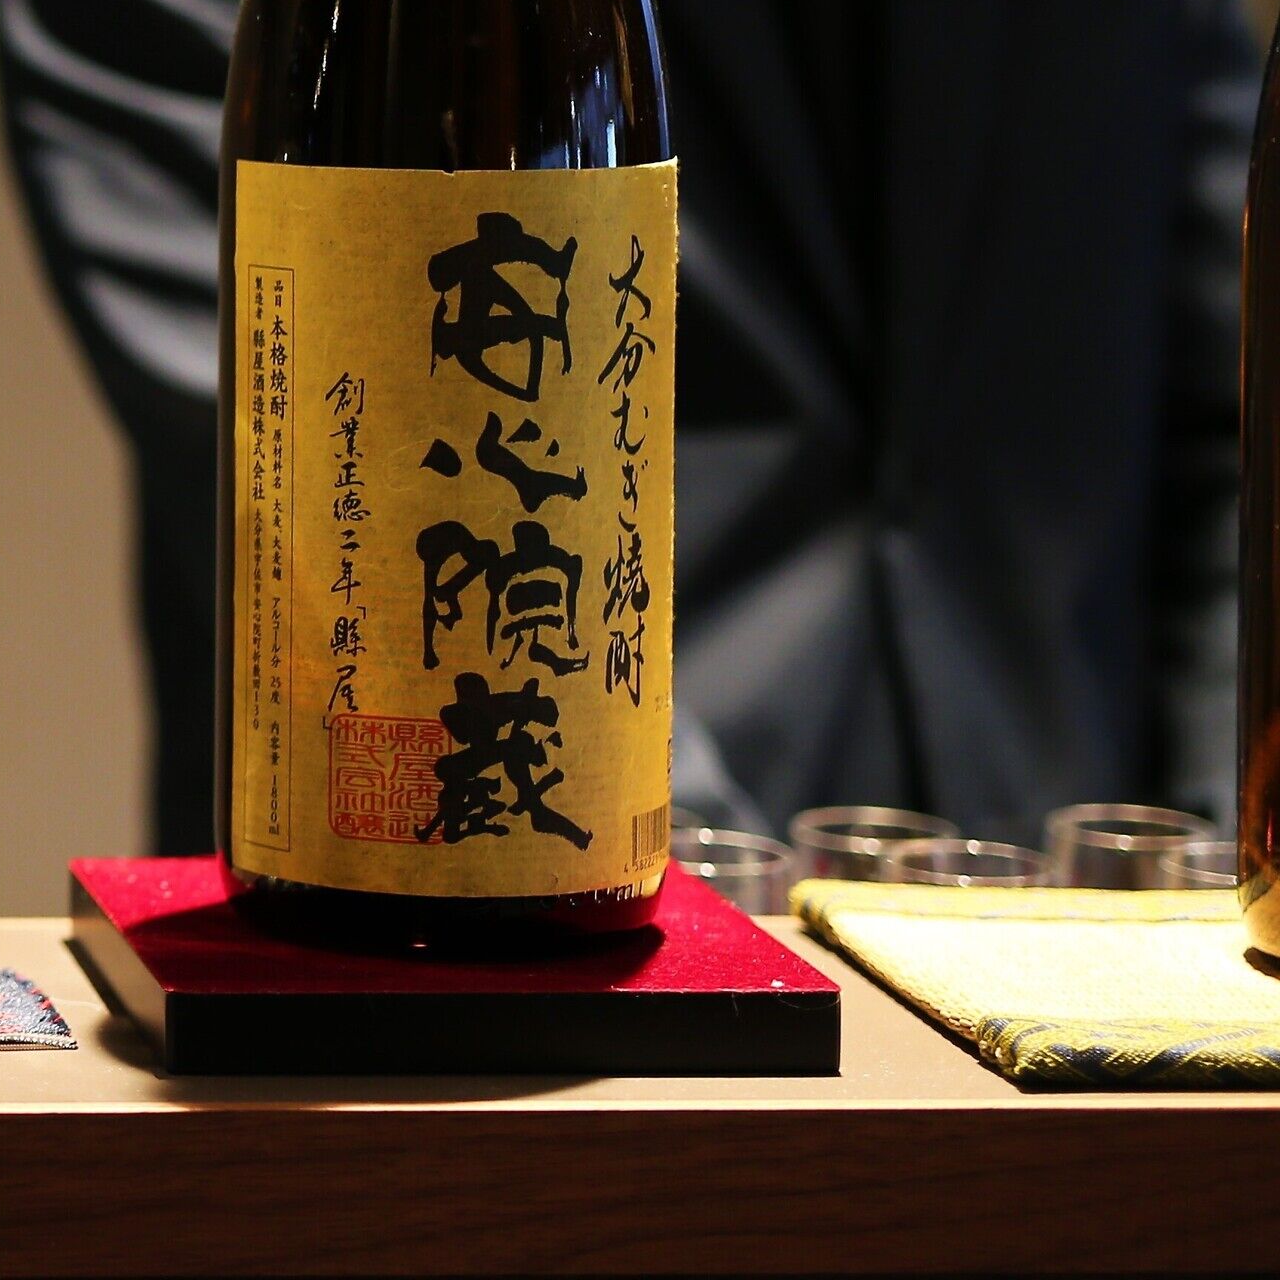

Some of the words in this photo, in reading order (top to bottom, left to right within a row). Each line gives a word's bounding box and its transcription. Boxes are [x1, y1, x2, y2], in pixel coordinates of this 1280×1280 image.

[269, 314, 288, 421] 本格焼酎
[271, 597, 282, 668] アルコール分
